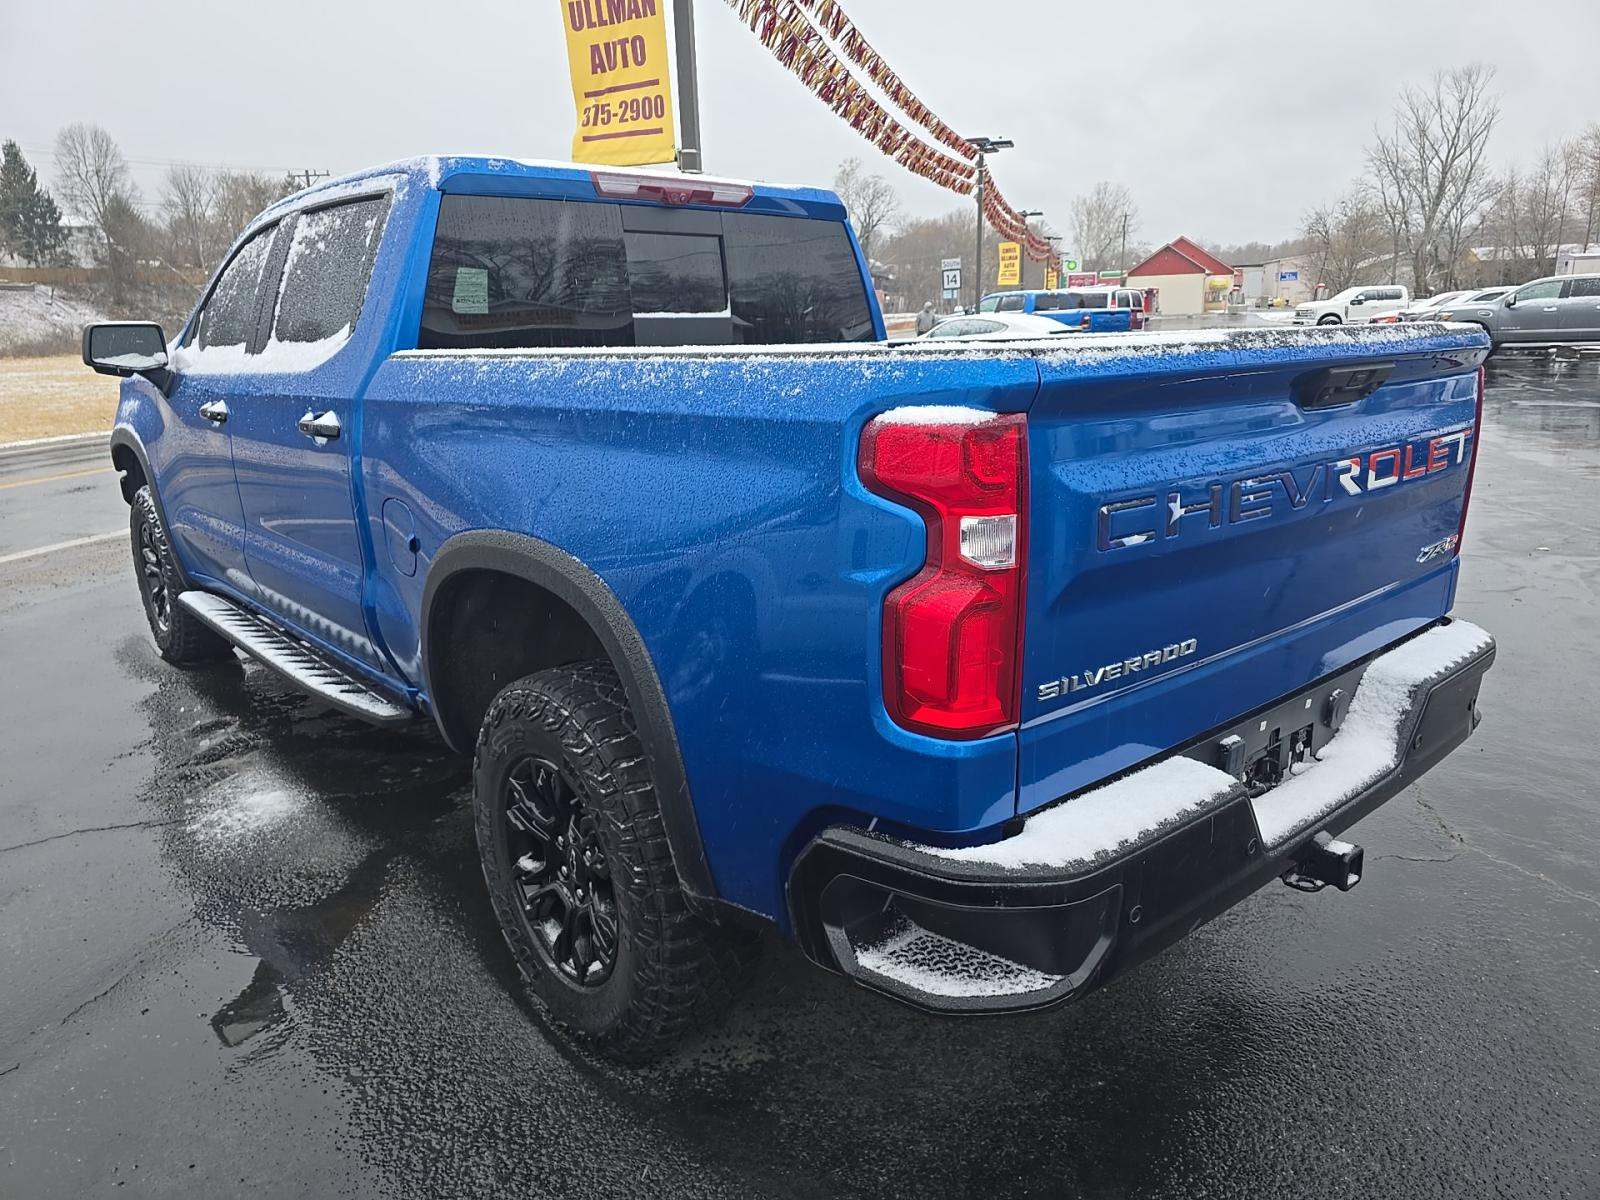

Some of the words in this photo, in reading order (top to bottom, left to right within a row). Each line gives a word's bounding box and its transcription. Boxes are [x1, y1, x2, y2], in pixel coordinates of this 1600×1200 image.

[568, 0, 656, 31] ULLMAN
[590, 34, 647, 75] AUTO
[581, 94, 665, 127] 375-2900
[946, 274, 957, 286] 14
[1098, 429, 1471, 551] CHEVROLET
[1038, 638, 1197, 701] SILVERADO
